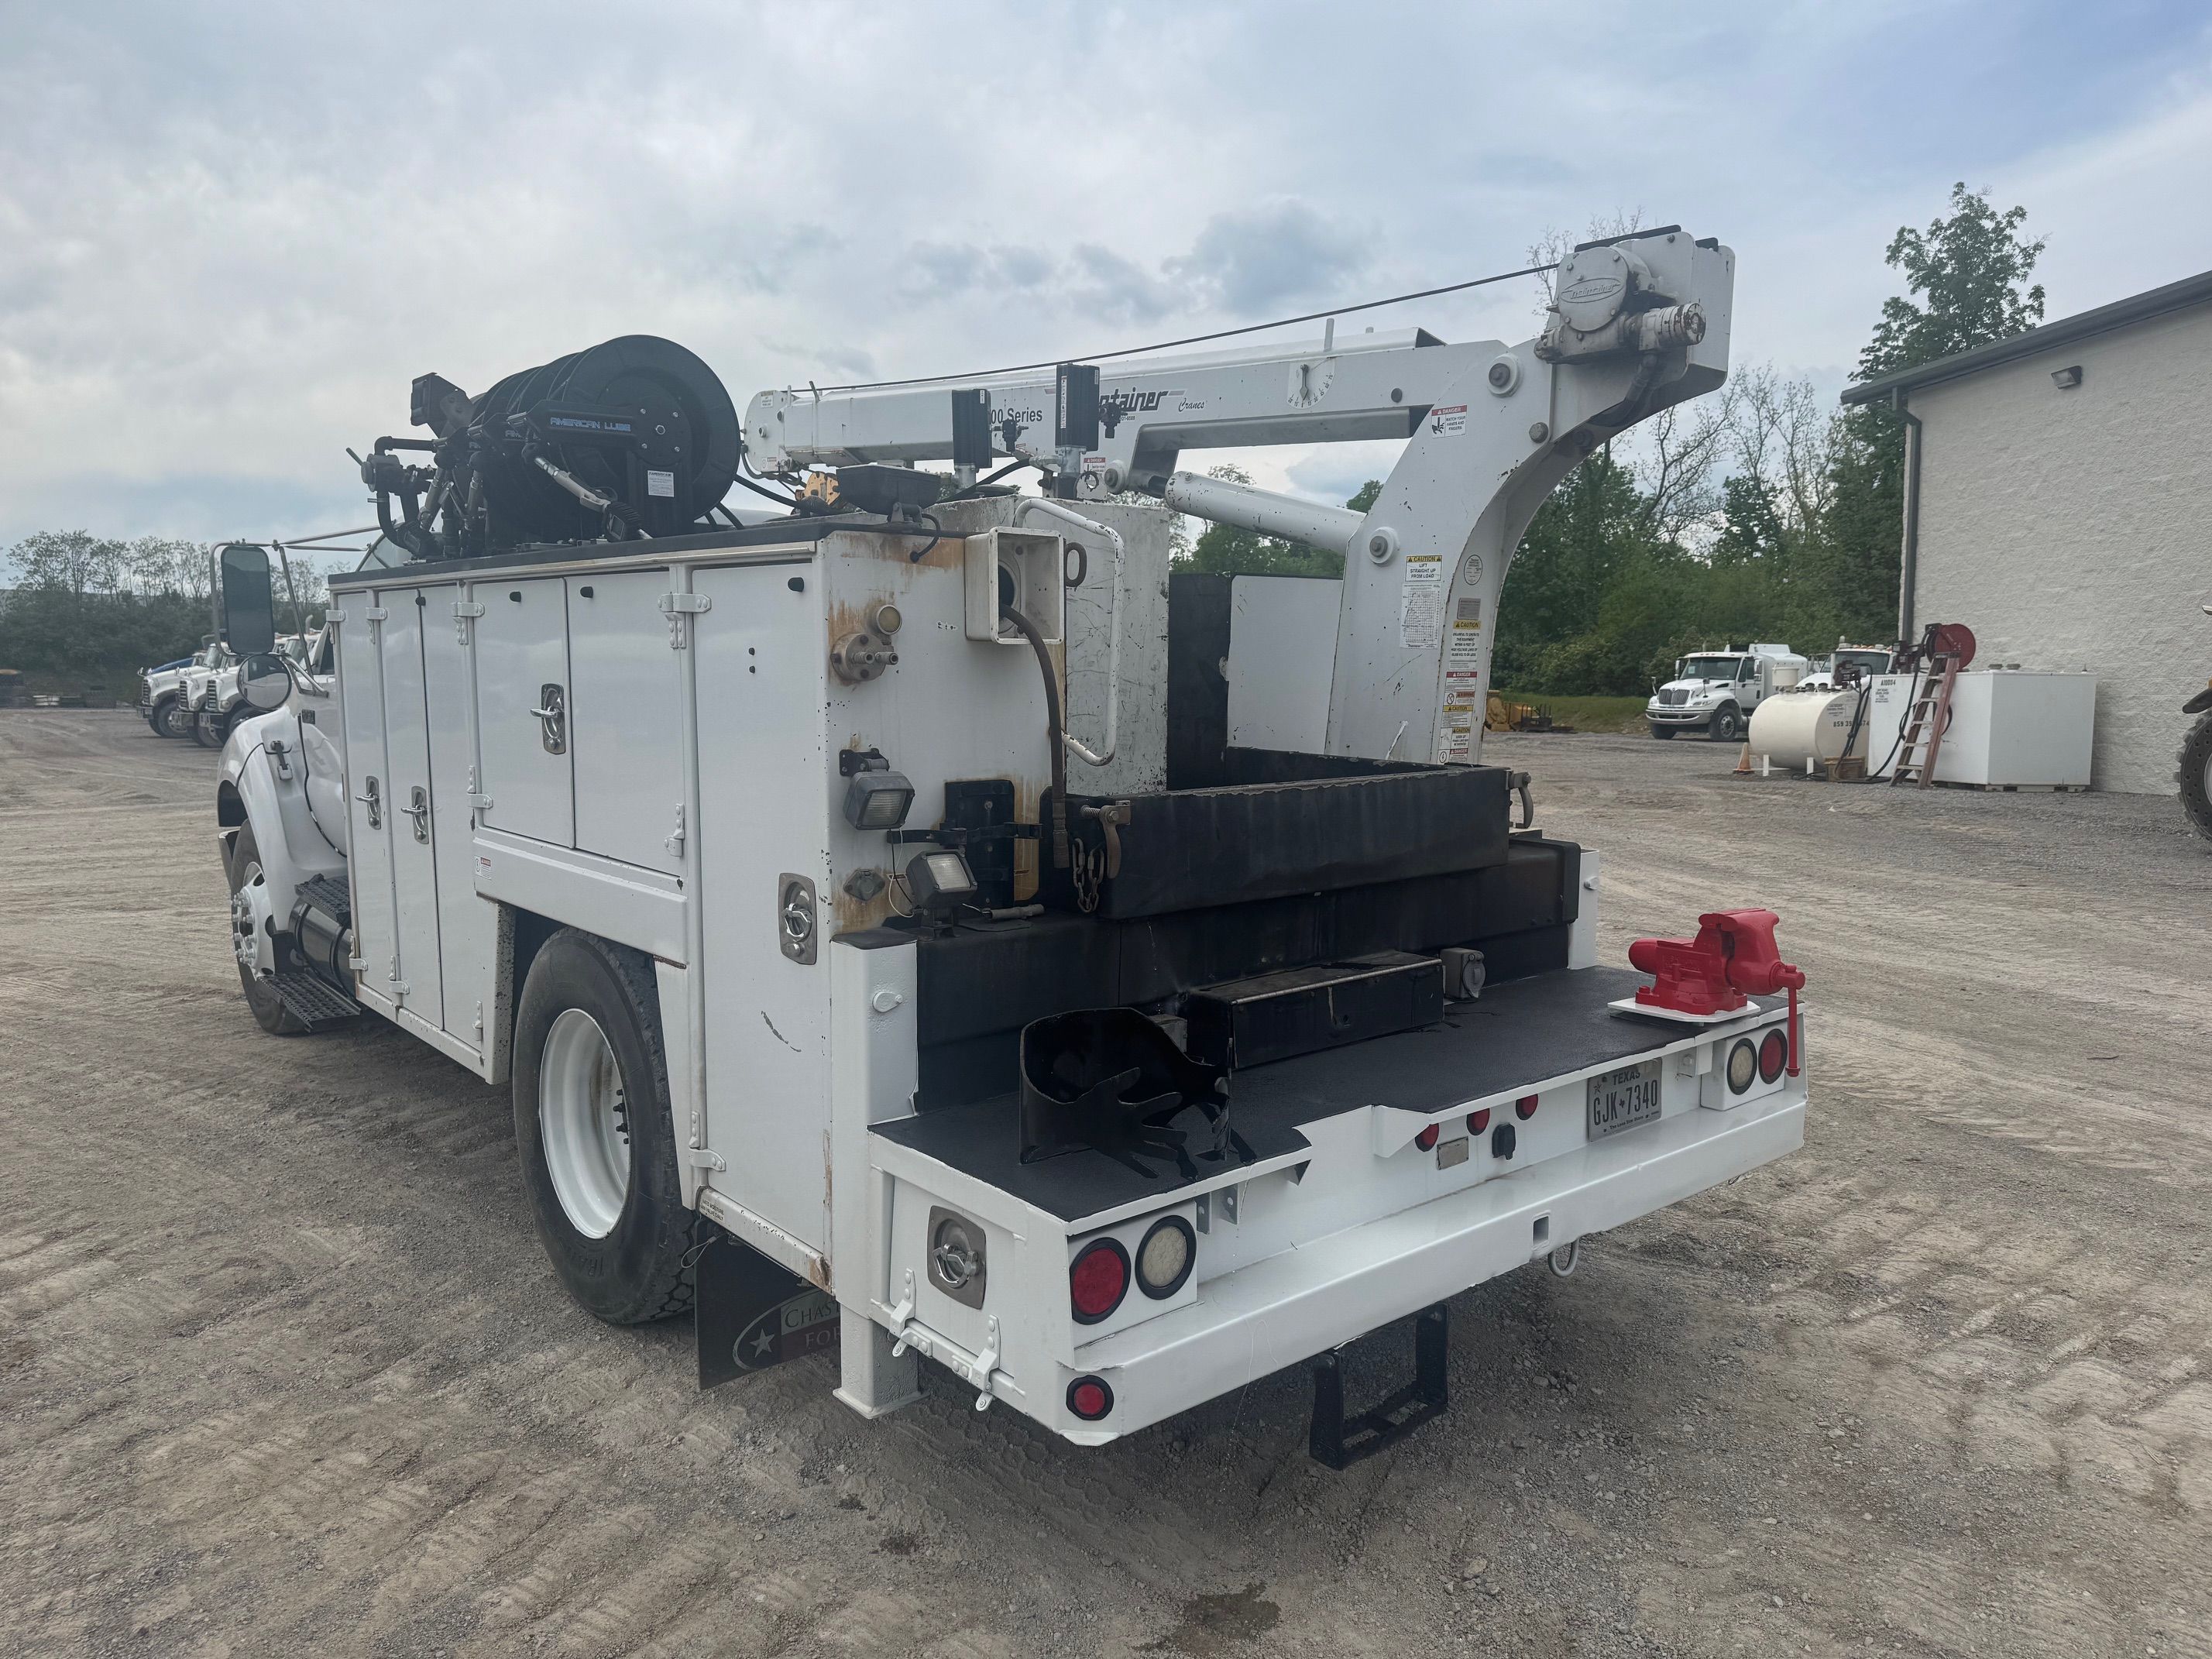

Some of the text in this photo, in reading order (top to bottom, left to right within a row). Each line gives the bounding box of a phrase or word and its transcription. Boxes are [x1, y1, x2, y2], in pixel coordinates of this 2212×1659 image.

[1099, 386, 1170, 412] ntainer
[1178, 397, 1205, 412] Cranes
[550, 417, 600, 429] AMERICAN
[991, 407, 1042, 424] 00 Series
[1613, 1071, 1640, 1086] TEXAS
[785, 1300, 841, 1328] CHAST
